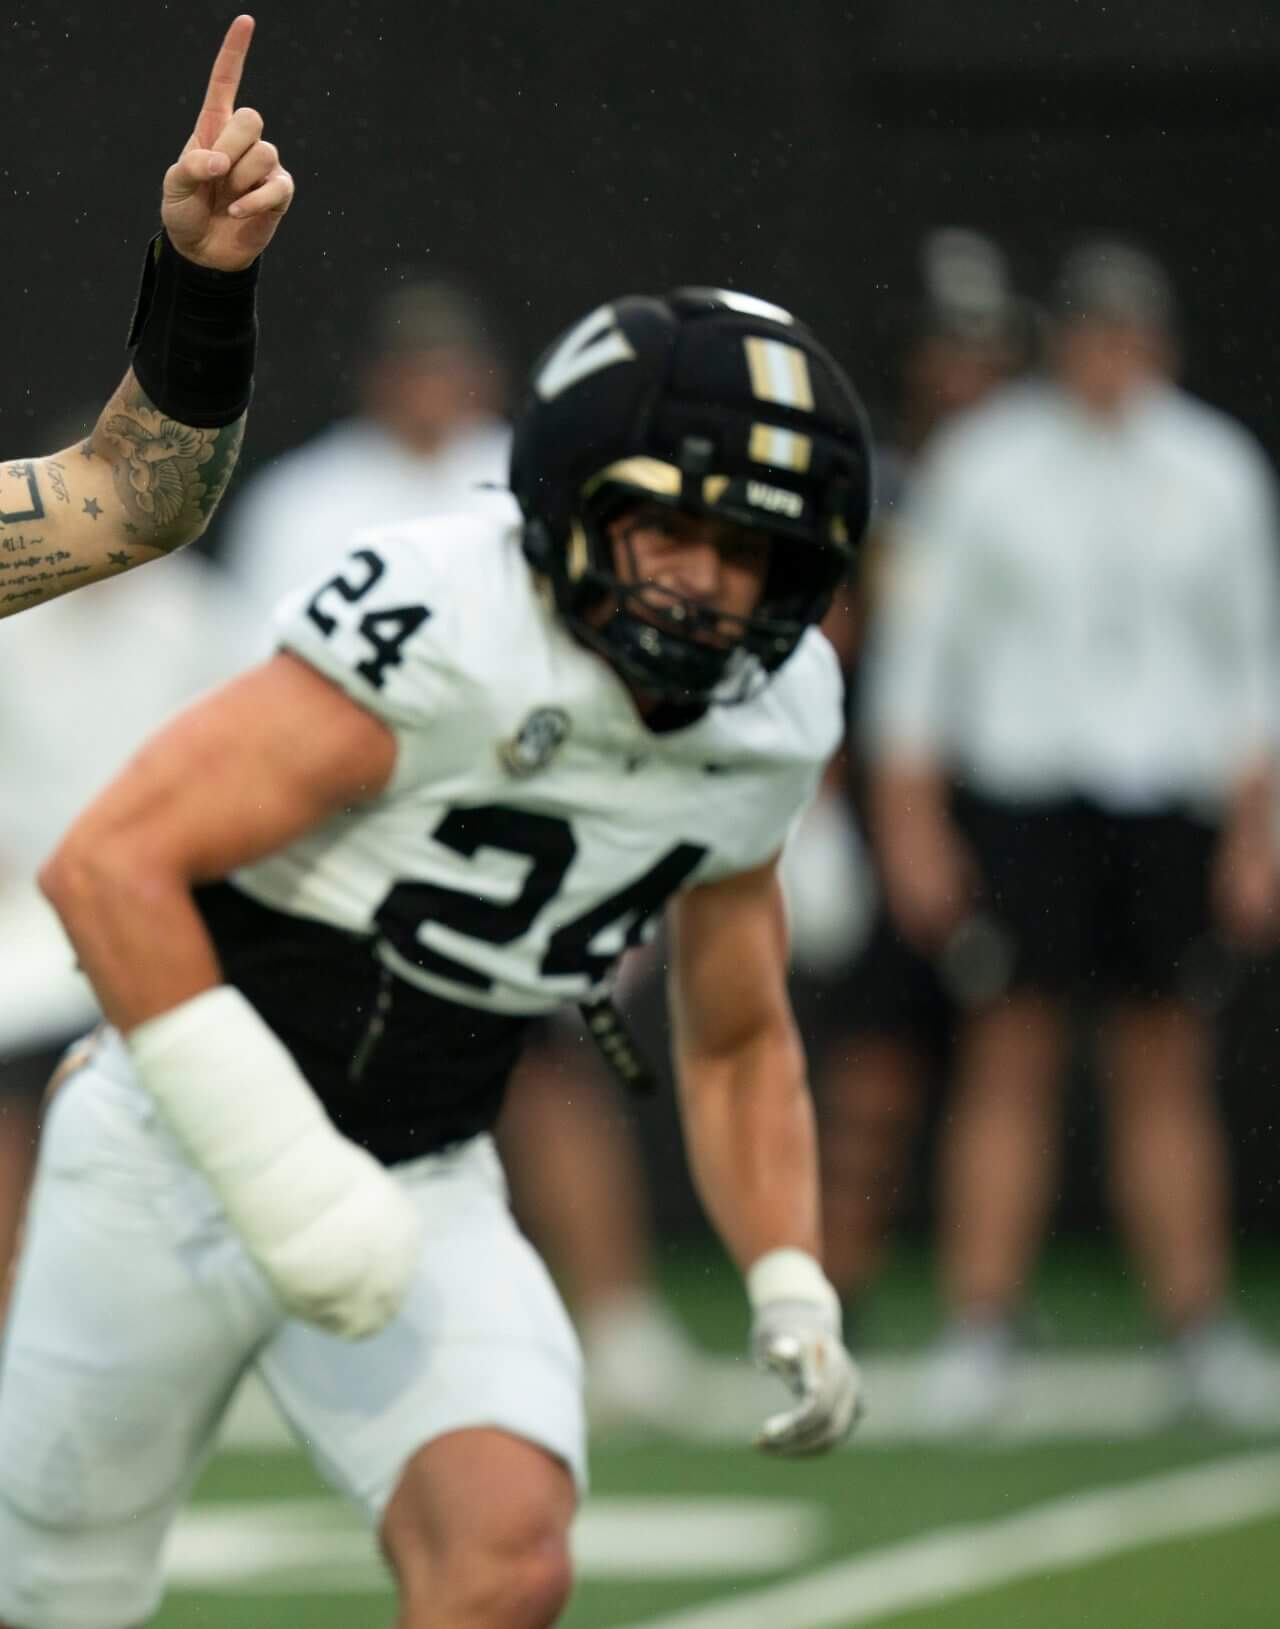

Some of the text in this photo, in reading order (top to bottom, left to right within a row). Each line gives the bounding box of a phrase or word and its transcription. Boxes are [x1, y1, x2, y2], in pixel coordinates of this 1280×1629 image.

[536, 304, 636, 403] V
[306, 549, 432, 690] 24
[372, 804, 713, 997] 24
